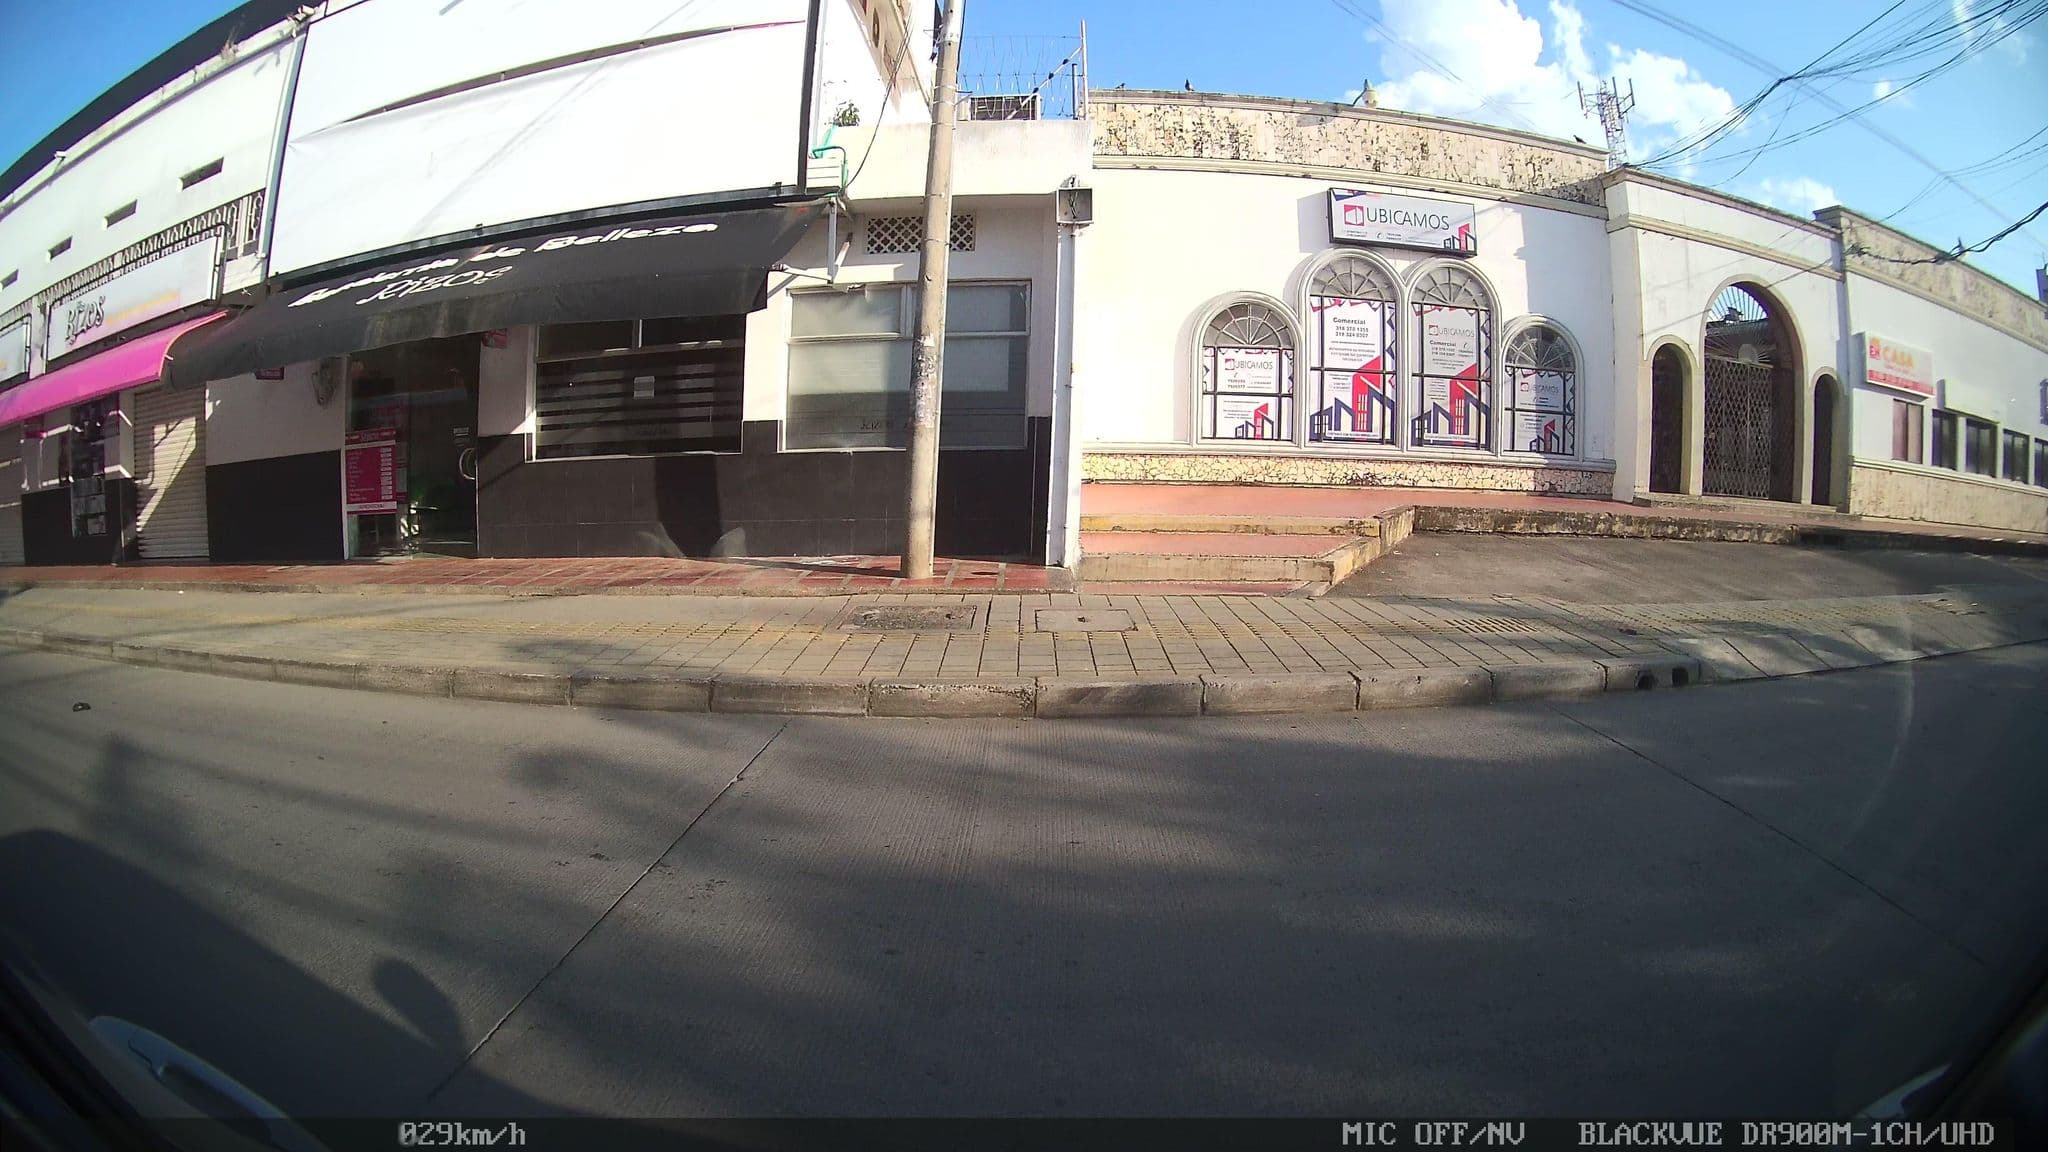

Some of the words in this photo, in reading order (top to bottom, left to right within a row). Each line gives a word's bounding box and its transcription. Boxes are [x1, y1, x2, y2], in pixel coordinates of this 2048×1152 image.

[1366, 206, 1450, 231] UBICAMOS
[533, 222, 719, 253] Belleza
[1332, 316, 1366, 325] Comercial
[1235, 360, 1274, 370] UBICAMOS
